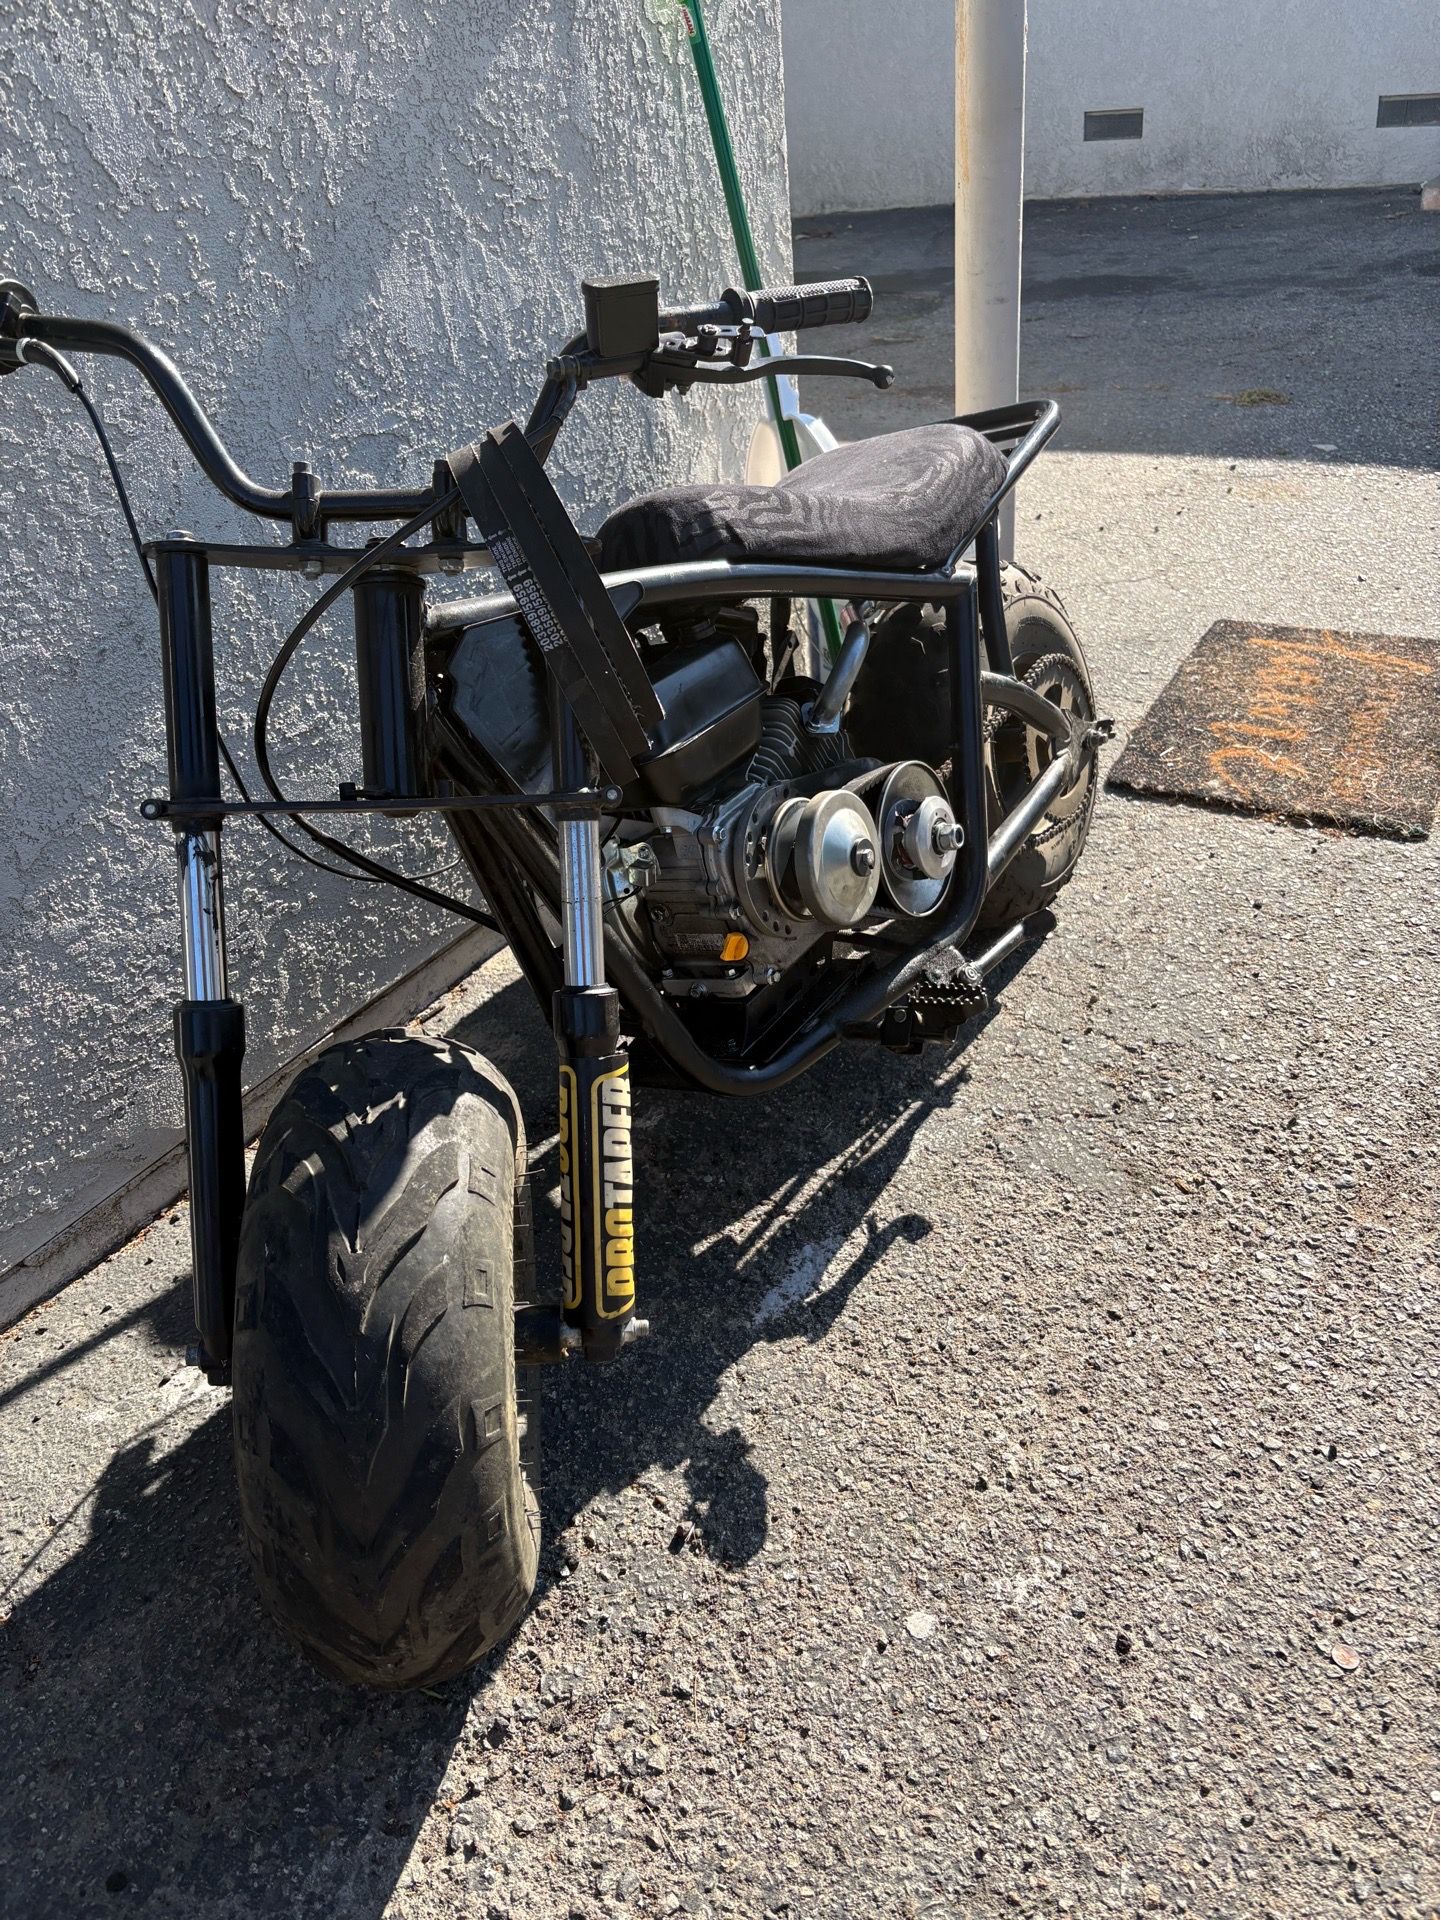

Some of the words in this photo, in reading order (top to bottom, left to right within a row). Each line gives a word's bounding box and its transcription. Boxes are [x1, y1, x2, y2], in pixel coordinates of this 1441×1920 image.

[491, 546, 501, 560] SIDE
[495, 540, 509, 563] ENGINE
[501, 540, 511, 555] SIDE
[505, 536, 519, 558] ENGINE
[498, 559, 507, 573] THIS
[505, 562, 513, 572] TO
[509, 554, 517, 569] THIS
[515, 557, 523, 566] TO
[513, 583, 554, 652] 203589/5959
[523, 578, 563, 647] 203589/5959
[601, 1077, 635, 1297] PROTAPER
